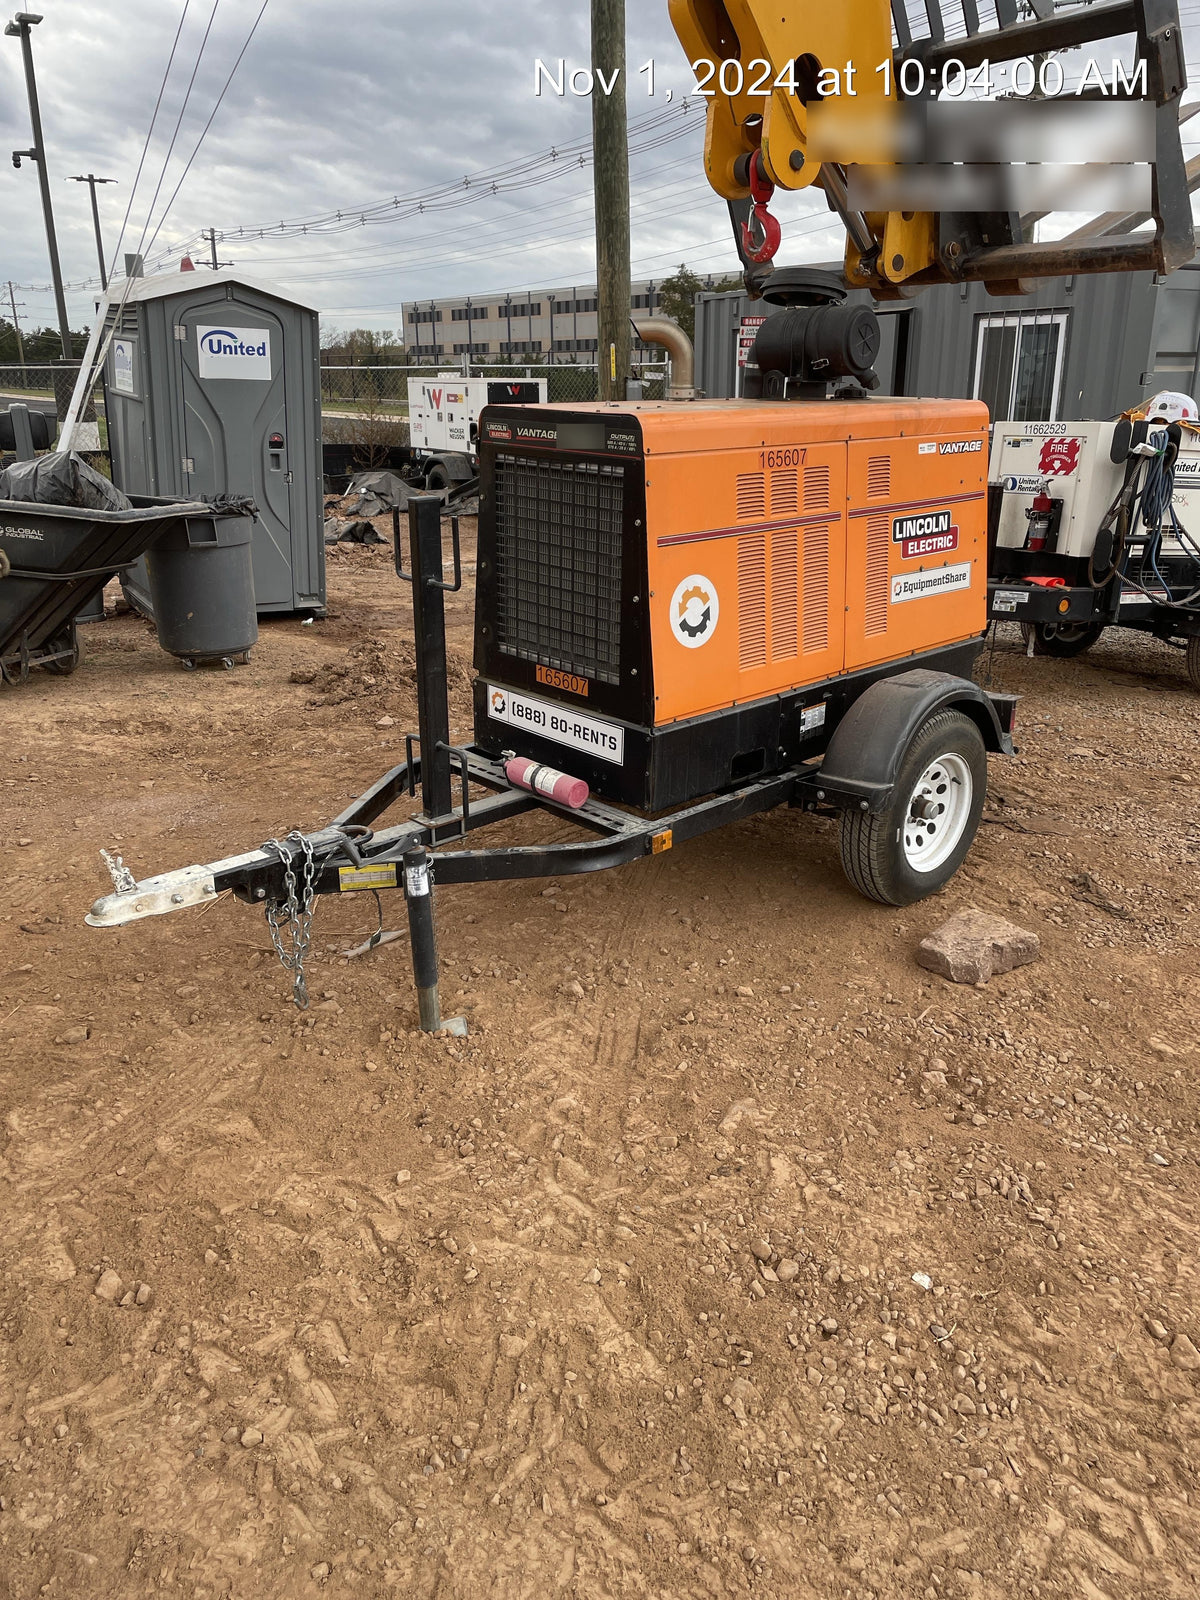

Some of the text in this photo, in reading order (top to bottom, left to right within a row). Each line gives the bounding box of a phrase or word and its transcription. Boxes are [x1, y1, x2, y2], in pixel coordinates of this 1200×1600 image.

[208, 338, 266, 357] United
[486, 424, 507, 432] LINCOLN
[1024, 423, 1067, 435] 11662529
[939, 440, 983, 455] VANTAGE
[1050, 444, 1069, 453] FIRE
[760, 448, 807, 468] 165607
[1174, 462, 1197, 473] nited
[1018, 477, 1040, 485] United
[5, 526, 44, 536] GLOBAL
[895, 514, 949, 539] LINCOLN
[907, 535, 953, 555] ELECTRIC
[903, 571, 967, 593] EquipmentShare
[537, 667, 587, 694] 165607
[512, 701, 617, 751] (888) 80-RENTS
